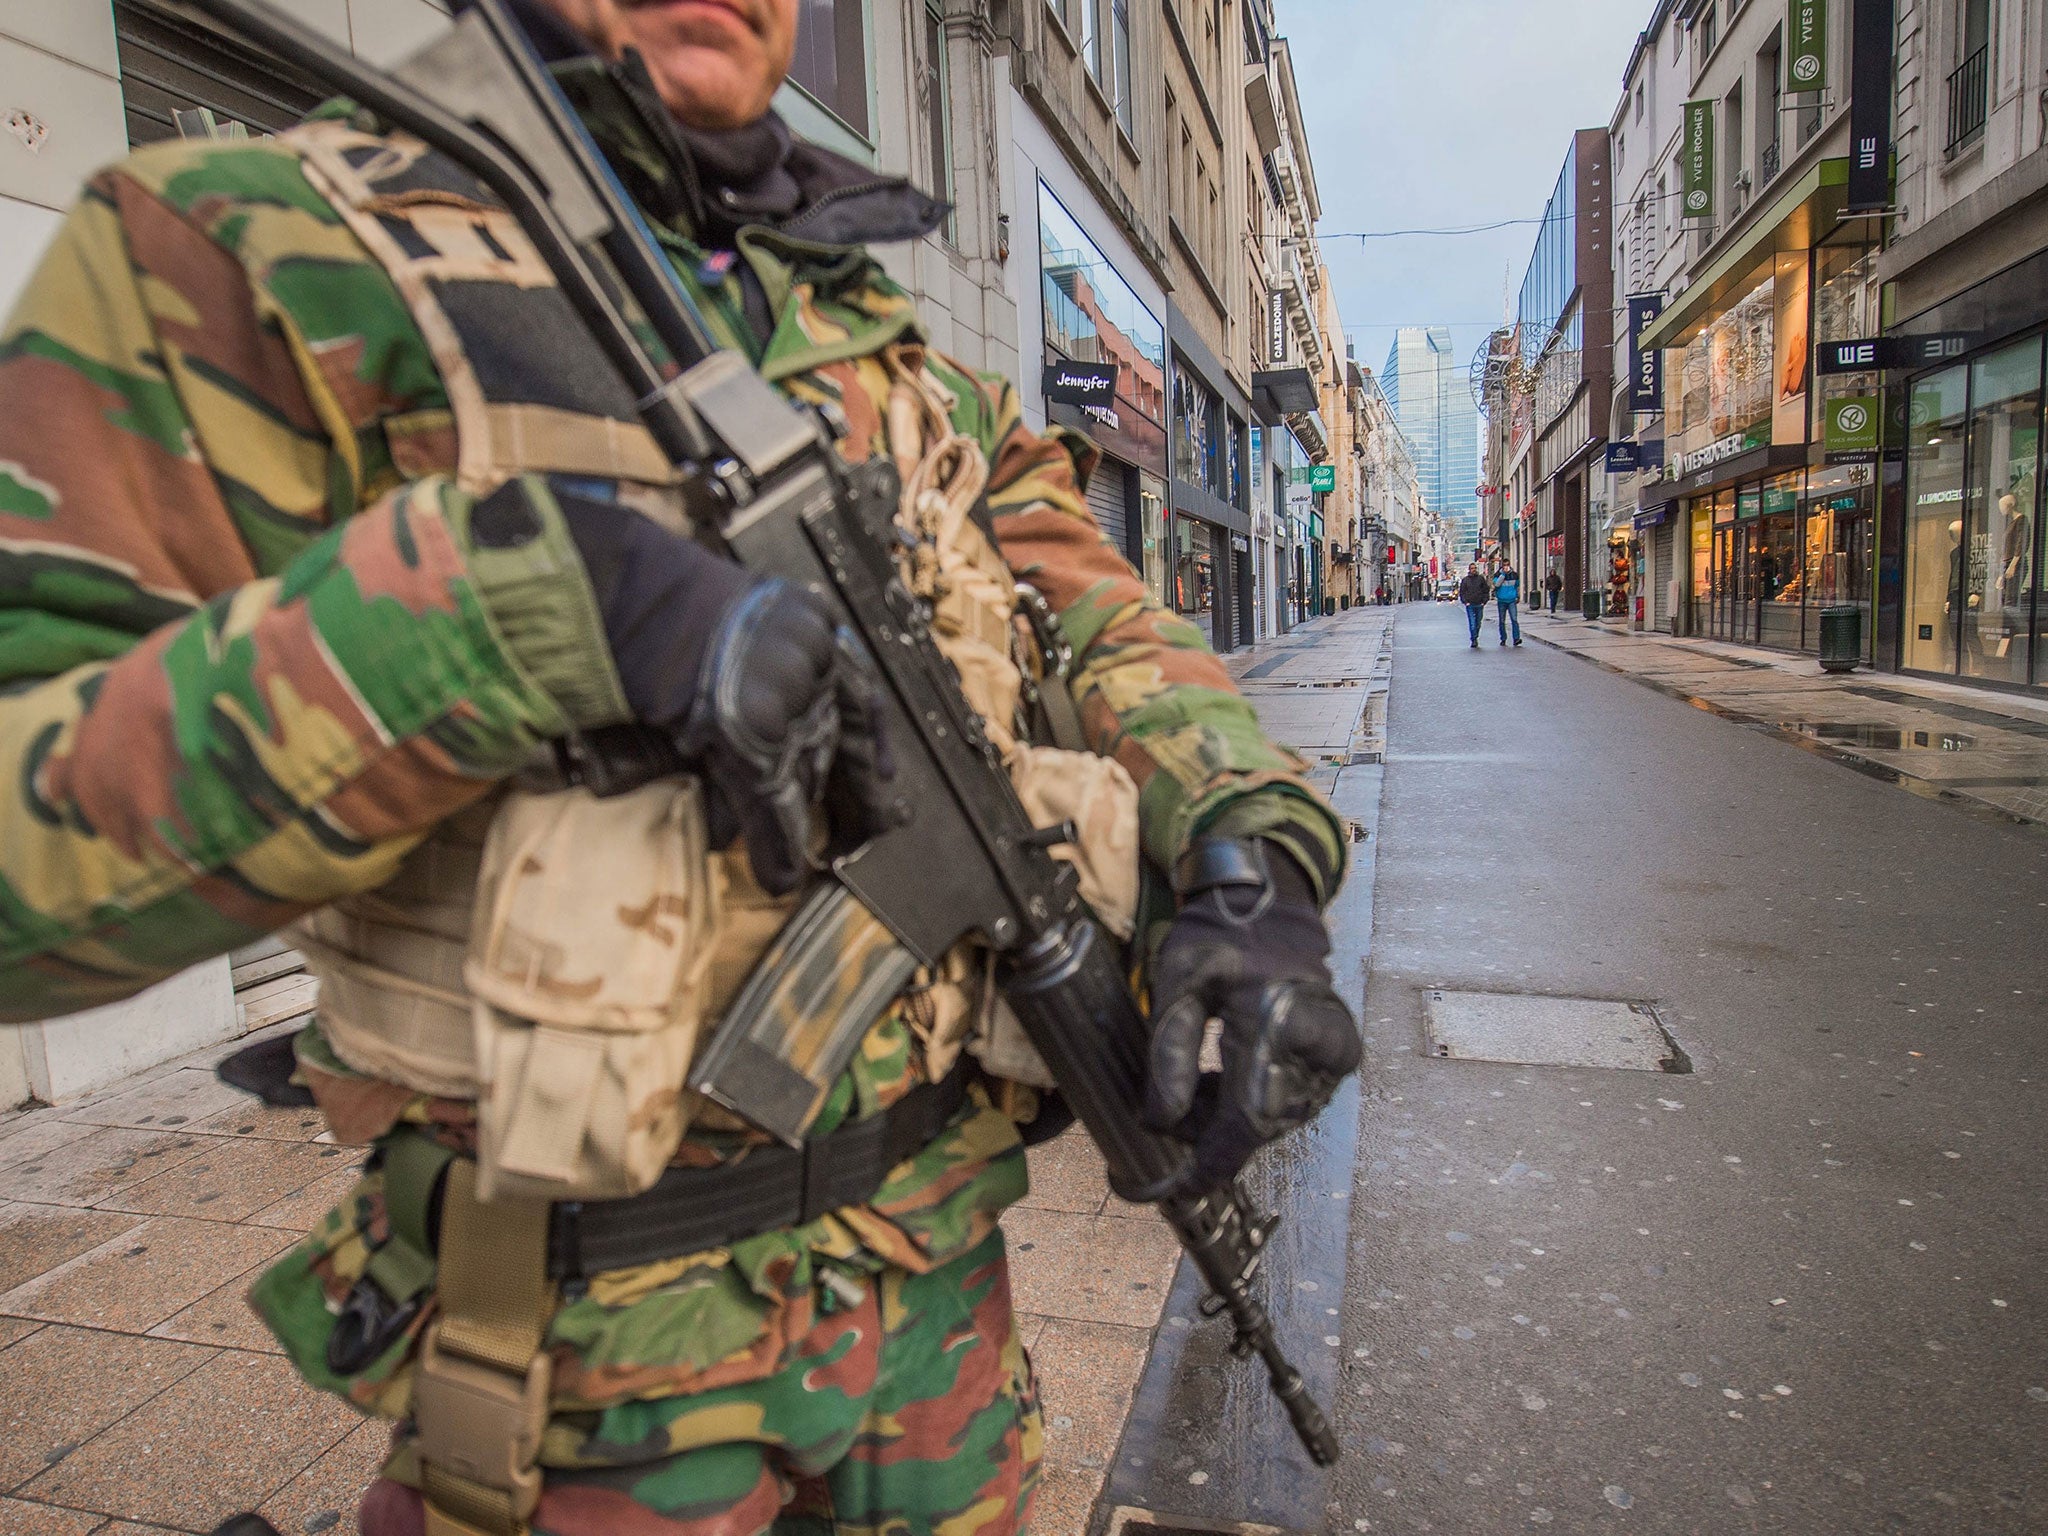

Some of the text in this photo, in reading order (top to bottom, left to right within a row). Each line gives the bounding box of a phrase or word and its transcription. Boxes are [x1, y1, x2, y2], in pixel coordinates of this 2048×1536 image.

[1802, 7, 1813, 44] YVES
[1694, 107, 1703, 182] YVES ROCHER
[1860, 137, 1876, 169] WE
[1592, 163, 1600, 251] SISLEY
[1274, 293, 1283, 360] CALZEDONIA
[1637, 309, 1653, 397] Leonas
[1838, 344, 1875, 365] WE
[1057, 372, 1110, 392] Jennyfer
[1970, 532, 1993, 549] STYLE
